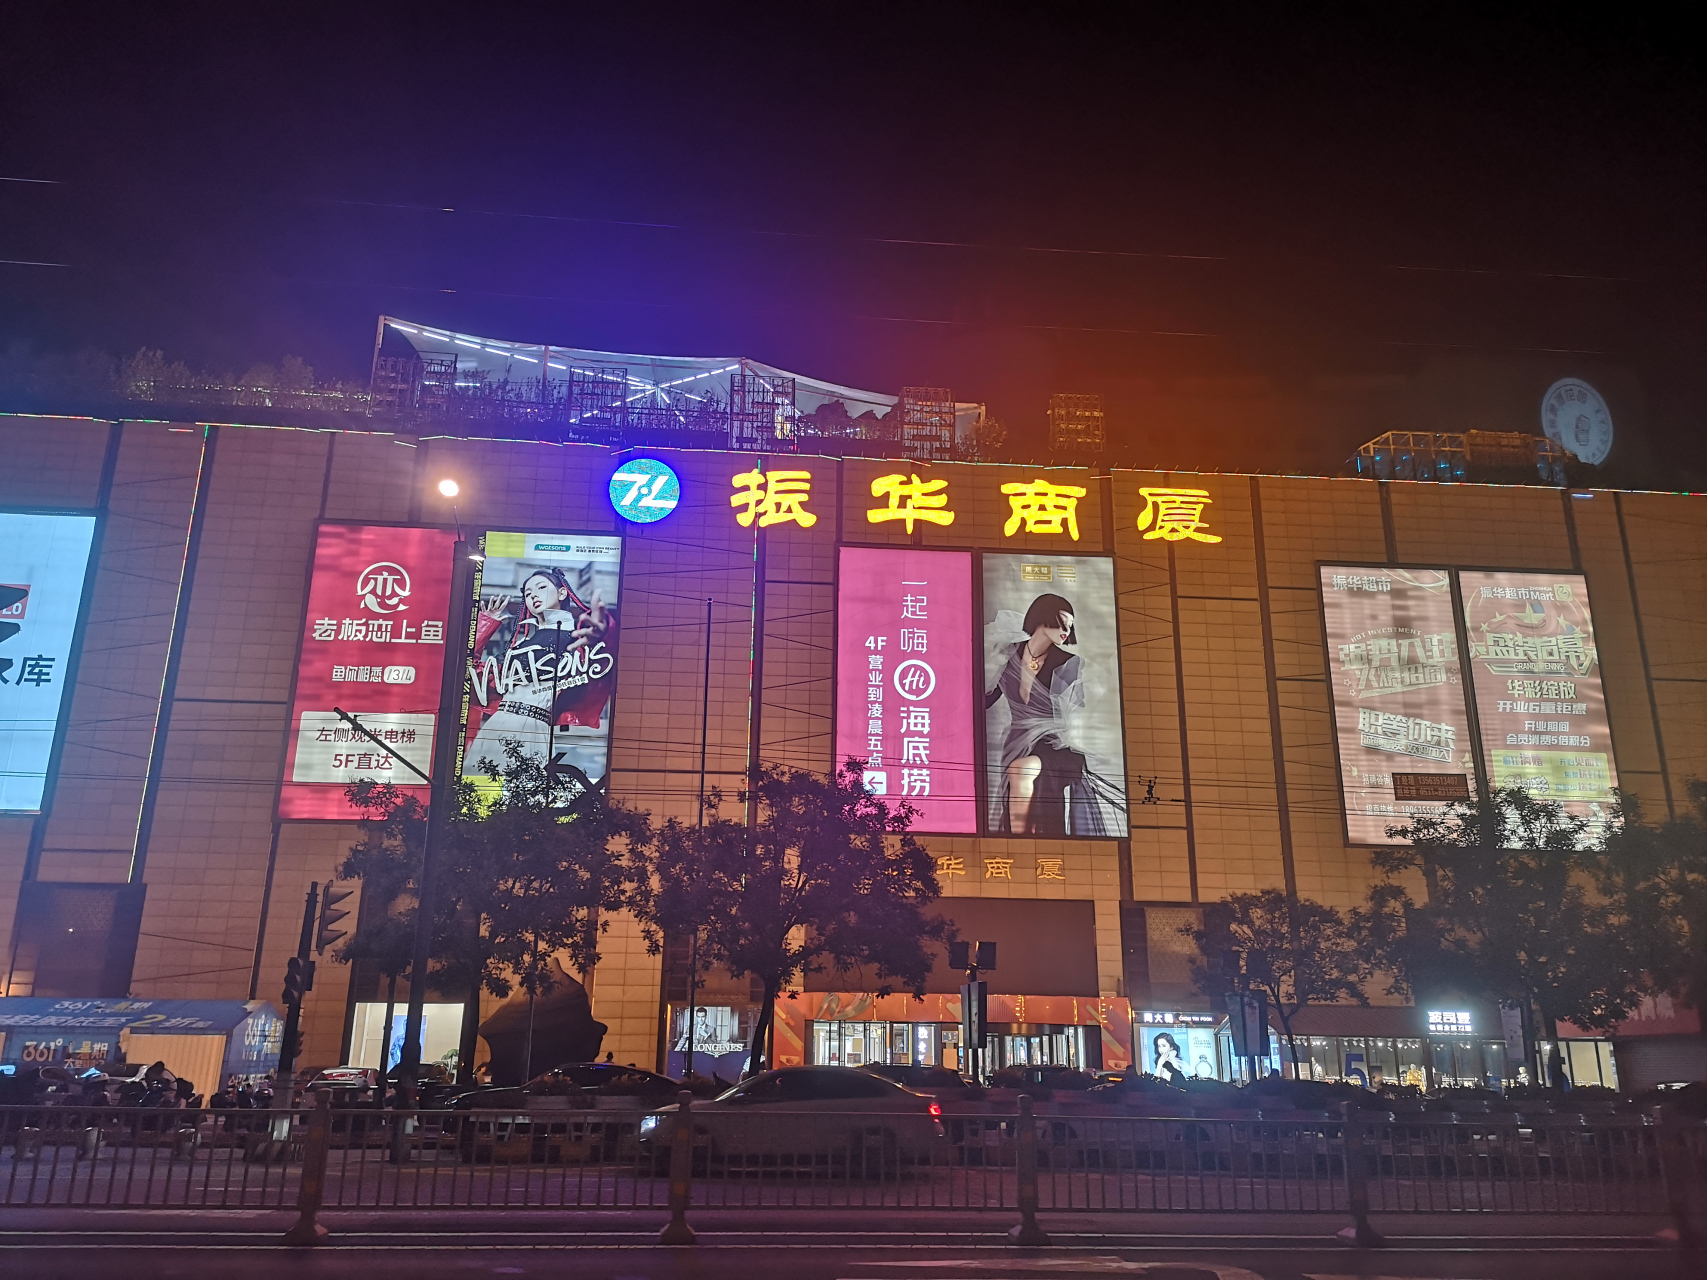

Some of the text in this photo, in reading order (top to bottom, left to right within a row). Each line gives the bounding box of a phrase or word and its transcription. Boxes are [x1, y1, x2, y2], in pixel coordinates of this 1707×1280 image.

[730, 468, 1223, 544] 振华商厦
[1332, 574, 1392, 592] 振华超市
[1480, 586, 1530, 600] 振华超市
[1531, 591, 1555, 600] Mart
[312, 617, 444, 644] 老板恋上鱼
[467, 620, 477, 649] DEMAND
[1351, 626, 1422, 643] HOT INVESTMENT
[1338, 632, 1459, 671] 强势入驻
[1481, 631, 1588, 671] 盛装启幕
[332, 665, 383, 682] 鱼你相恋
[469, 640, 614, 707] WATSONS
[1513, 662, 1536, 670] GRAND
[1354, 662, 1447, 690] 火爆招商
[900, 581, 931, 797] 一起嗨 Hi 海底捞
[1506, 679, 1578, 699] 华彩绽放
[1497, 700, 1588, 715] 开业6重钜惠
[315, 726, 416, 744] 左侧观光电梯
[1358, 707, 1457, 750] 职等你来
[1524, 720, 1570, 732] 开业期间
[1506, 733, 1591, 747] 会员消费5倍积分
[332, 752, 394, 771] 5F直达
[454, 745, 464, 777] DEMAND
[885, 855, 1066, 880] 华商厦
[1144, 1012, 1174, 1023] 周大福
[692, 1043, 744, 1052] LONGINES
